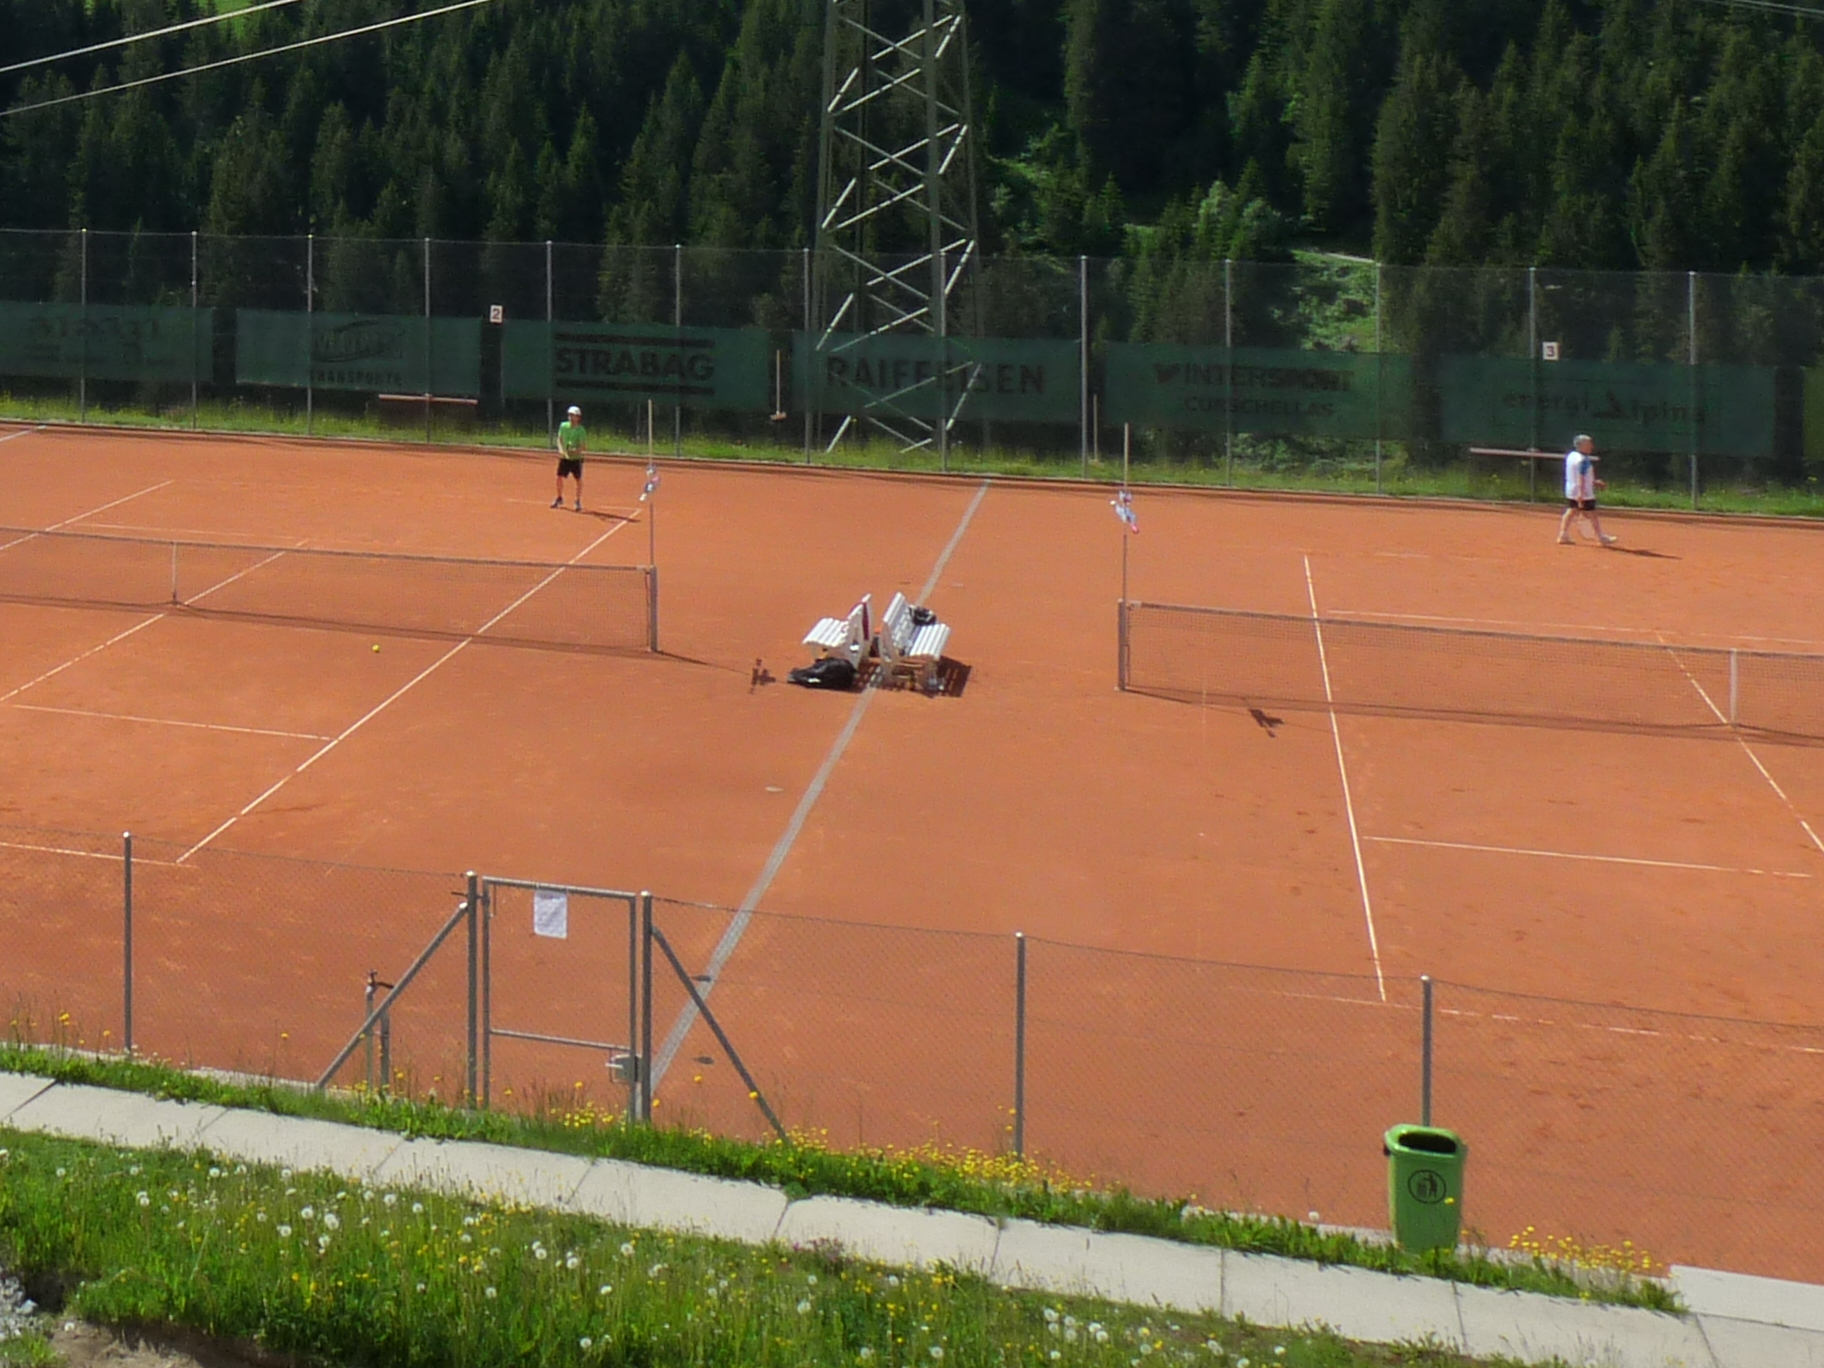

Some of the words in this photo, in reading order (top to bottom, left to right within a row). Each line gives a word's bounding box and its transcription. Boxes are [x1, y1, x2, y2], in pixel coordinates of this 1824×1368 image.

[492, 308, 501, 320] 2
[1546, 345, 1555, 357] 3
[556, 347, 714, 380] STRABAG
